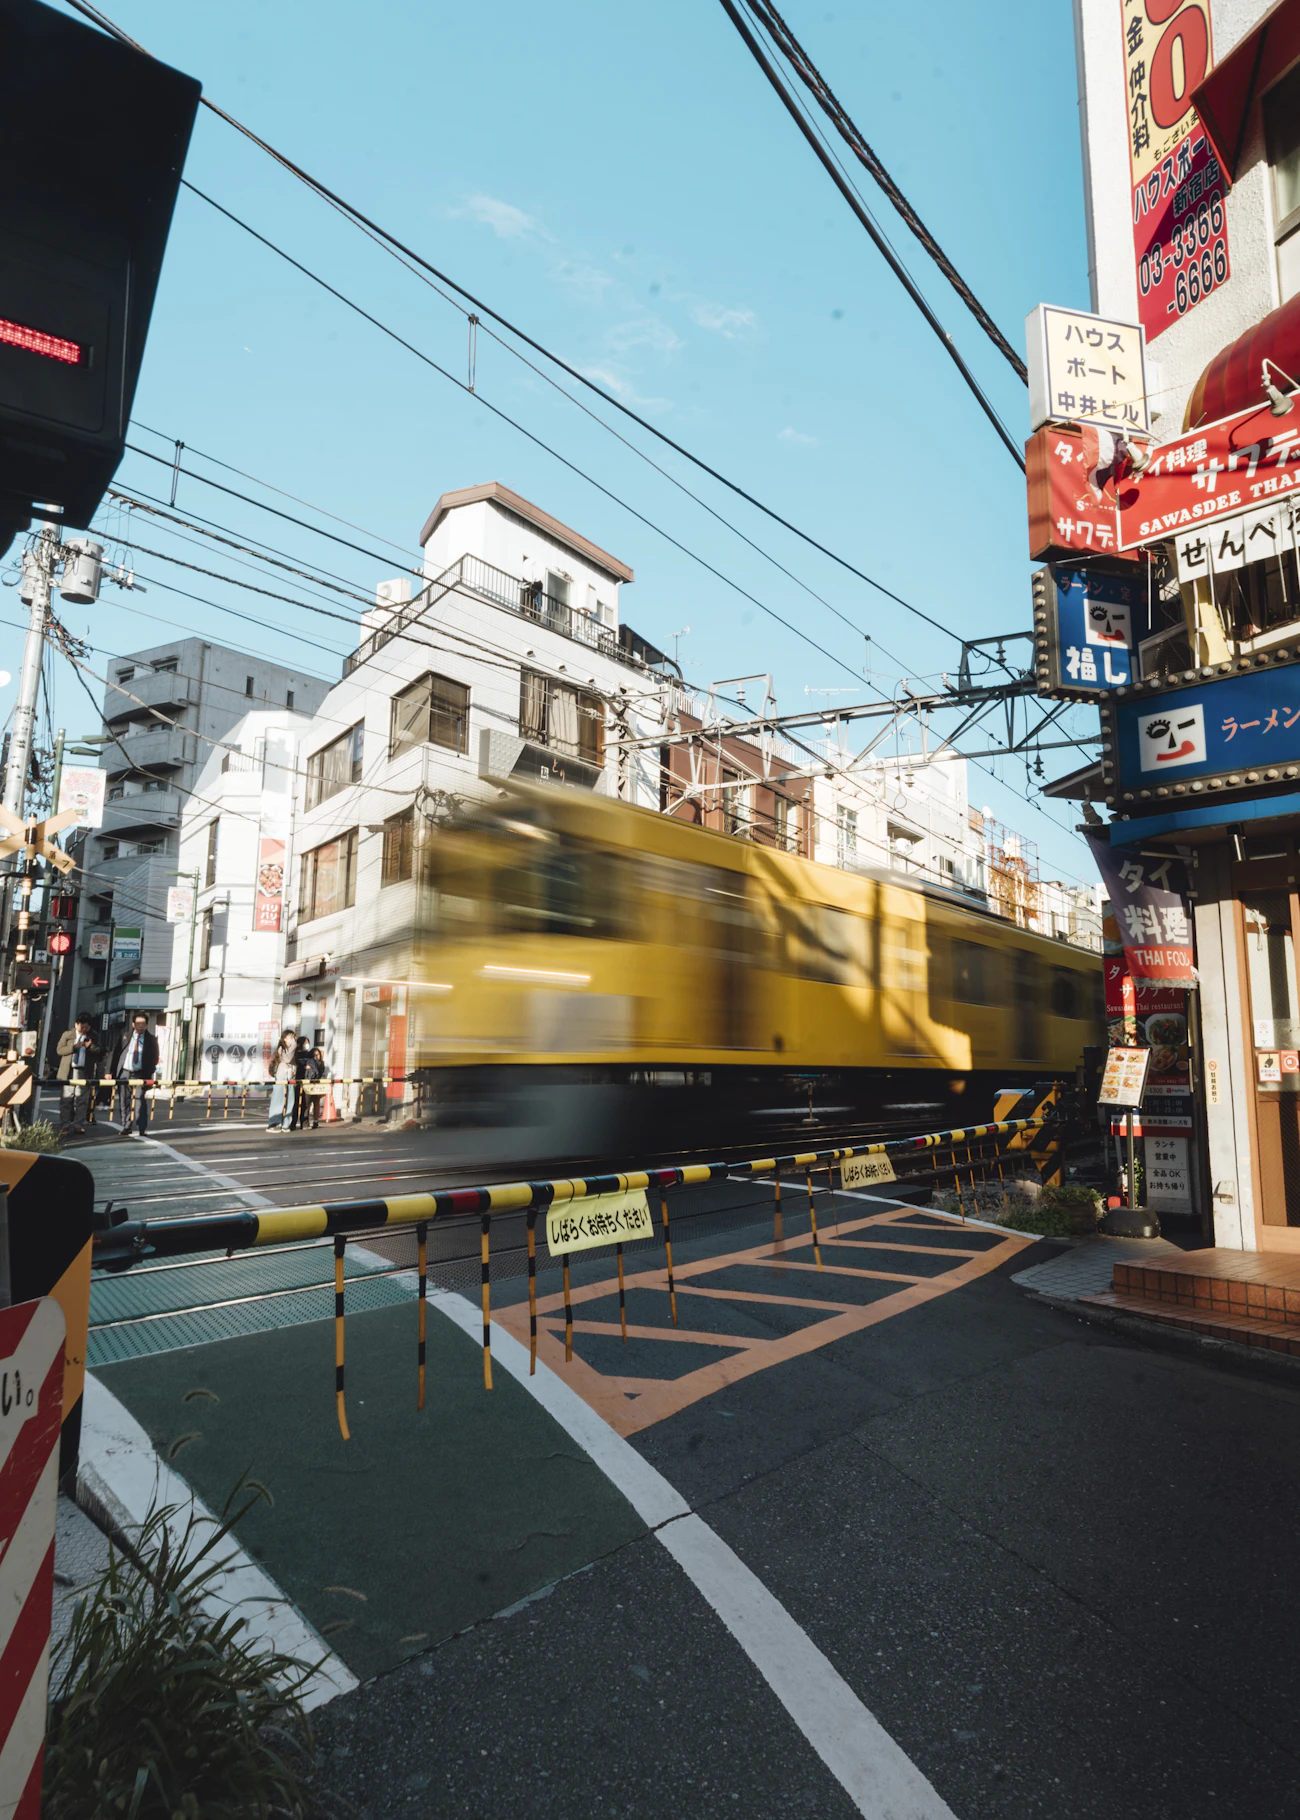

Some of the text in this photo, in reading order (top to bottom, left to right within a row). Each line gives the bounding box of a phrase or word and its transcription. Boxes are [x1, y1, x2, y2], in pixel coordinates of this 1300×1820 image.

[1173, 157, 1220, 218] 新宿店
[1139, 189, 1225, 296] 03-3366
[1167, 237, 1228, 316] -6666
[1065, 324, 1125, 353] ハウス
[1067, 357, 1126, 386] ポート
[1058, 391, 1139, 422] 中井ビル
[1139, 490, 1242, 536] SAWASDEE
[1222, 707, 1300, 743] ラーメン
[1119, 860, 1172, 893] タイ
[1124, 904, 1190, 945] 料理
[1134, 949, 1165, 966] THAI
[1106, 1002, 1184, 1012] Sawasdee Thai restaurant
[1154, 1140, 1176, 1148] ランチ
[1155, 1152, 1177, 1161] 営業中
[551, 1208, 648, 1244] しばらくお待ちください
